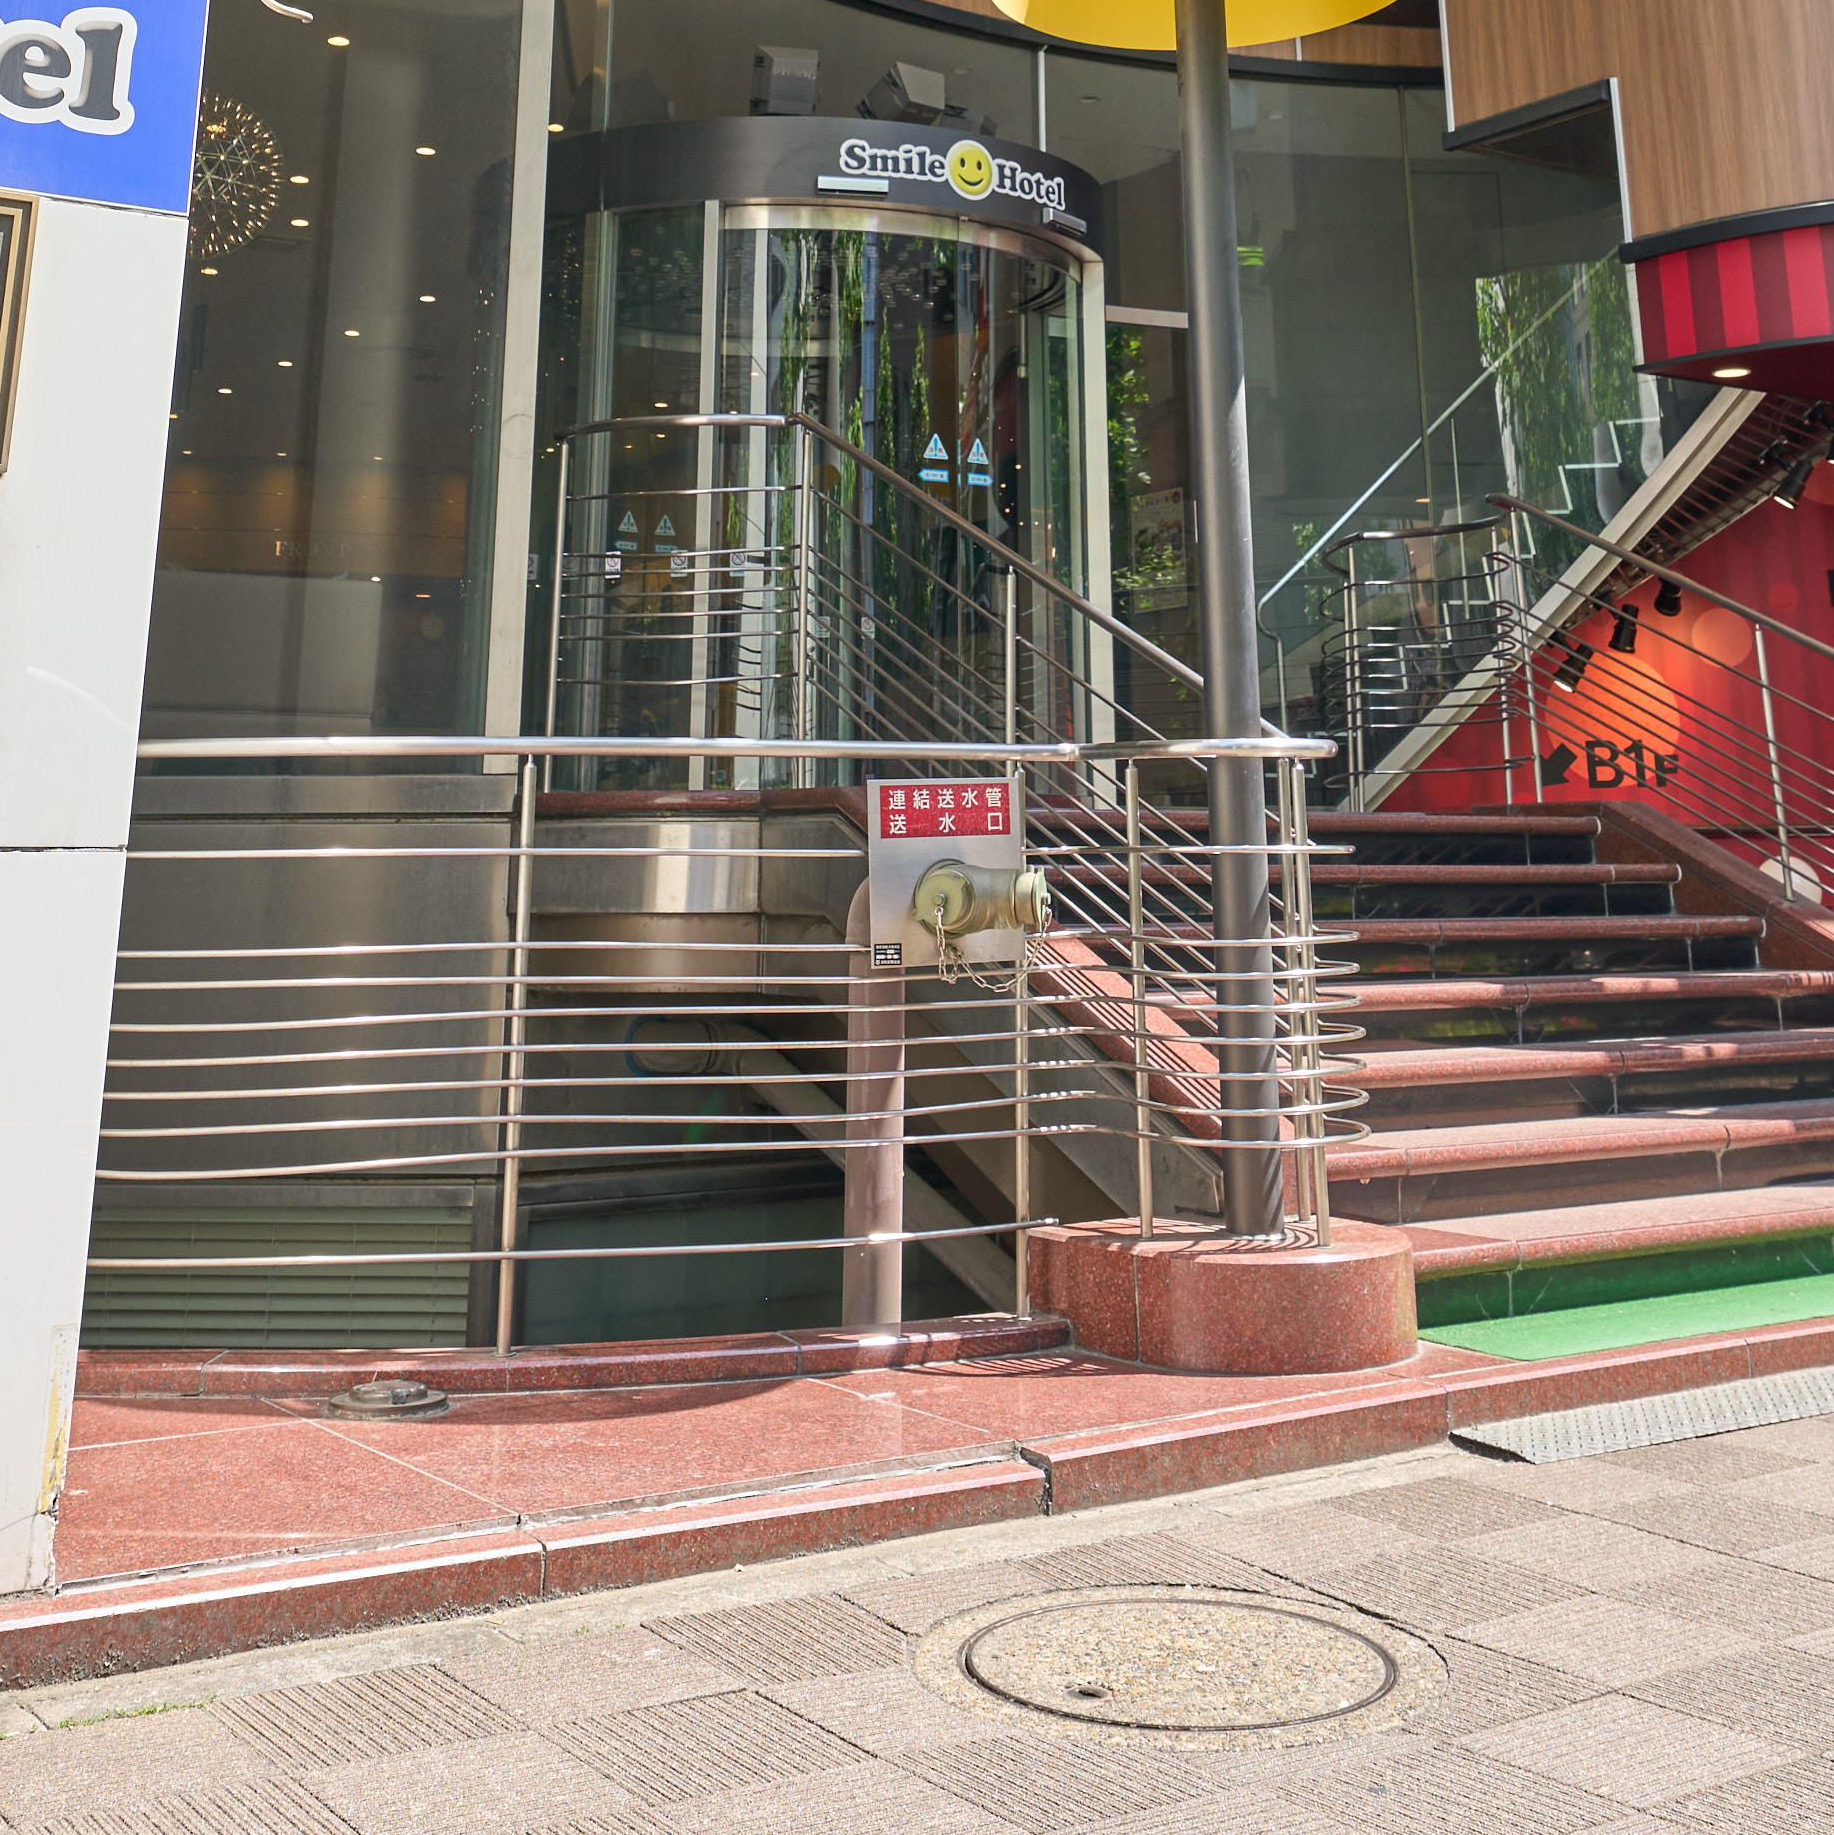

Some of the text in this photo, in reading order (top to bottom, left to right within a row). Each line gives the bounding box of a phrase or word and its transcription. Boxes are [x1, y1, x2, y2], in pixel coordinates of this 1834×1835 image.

[842, 142, 1065, 208] Smile Hotel
[1585, 739, 1679, 789] B1F
[888, 787, 1002, 810] 連結送水管
[889, 812, 1003, 835] 送水口
